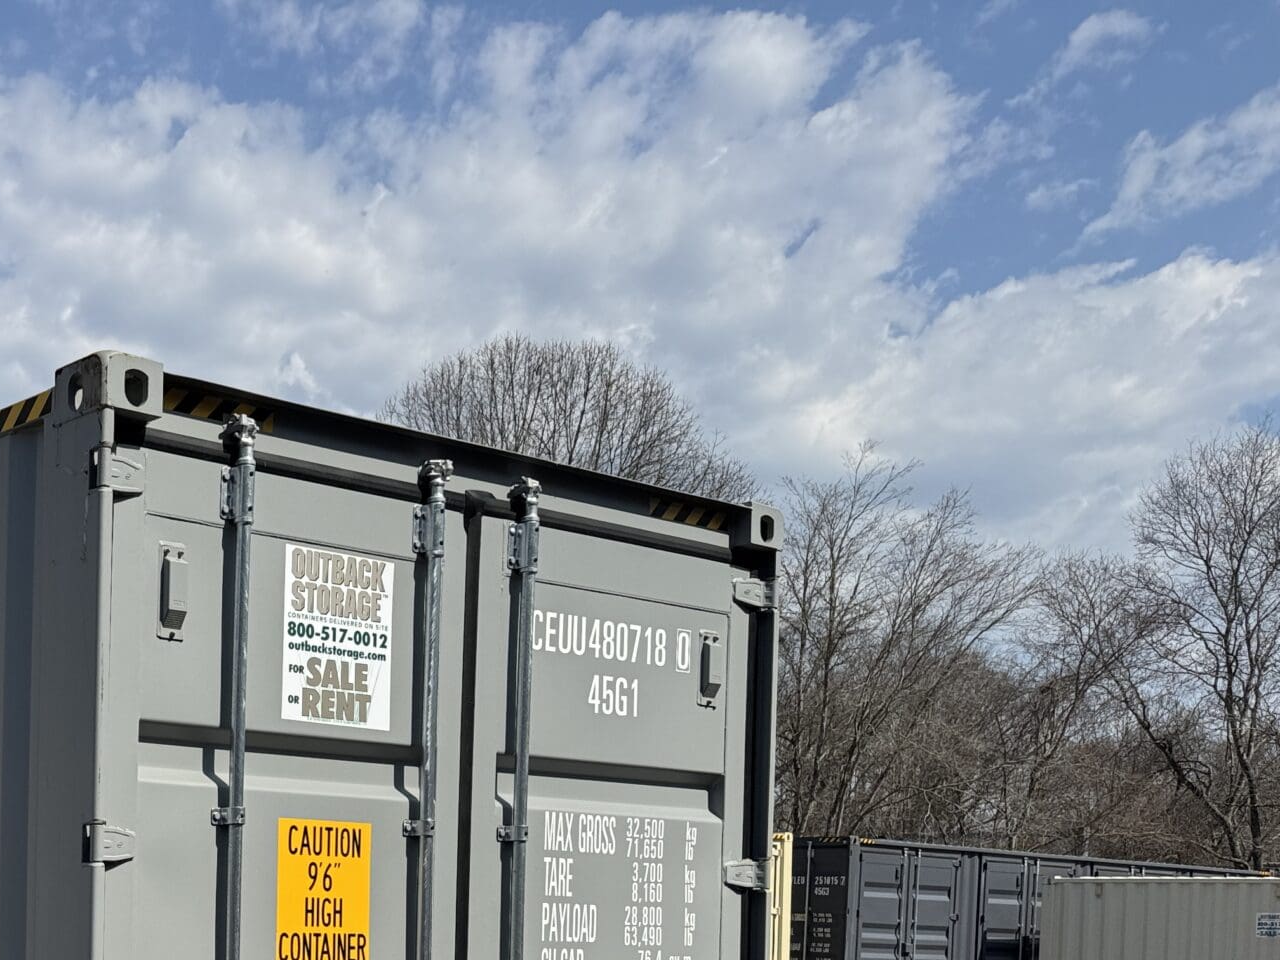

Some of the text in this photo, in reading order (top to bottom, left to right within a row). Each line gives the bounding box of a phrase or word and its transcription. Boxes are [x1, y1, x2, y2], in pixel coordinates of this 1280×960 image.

[291, 548, 386, 592] OUTBACK
[291, 581, 382, 623] STORAGE
[288, 612, 328, 624] CONTAINERS
[329, 618, 362, 628] DELIVERED
[288, 621, 388, 648] 800-517-0012
[288, 640, 386, 662] outbackstorage.com
[677, 632, 690, 670] 0
[288, 656, 368, 692] FOR SALE
[288, 694, 300, 704] OR
[302, 688, 372, 723] RENT
[588, 674, 639, 718] 45G1
[288, 825, 361, 858] CAUTION
[544, 810, 616, 854] MAX GROSS
[626, 817, 698, 846] 32,500 kg
[626, 838, 694, 861] 71,650 lb
[544, 857, 574, 897] TARE
[632, 862, 696, 888] 3,700 kg
[632, 883, 694, 904] 8,160 lb
[304, 897, 343, 928] HIGH
[542, 902, 597, 943] PAYLOAD
[624, 906, 696, 932] 28,800 kg
[624, 926, 693, 948] 63,490 lb
